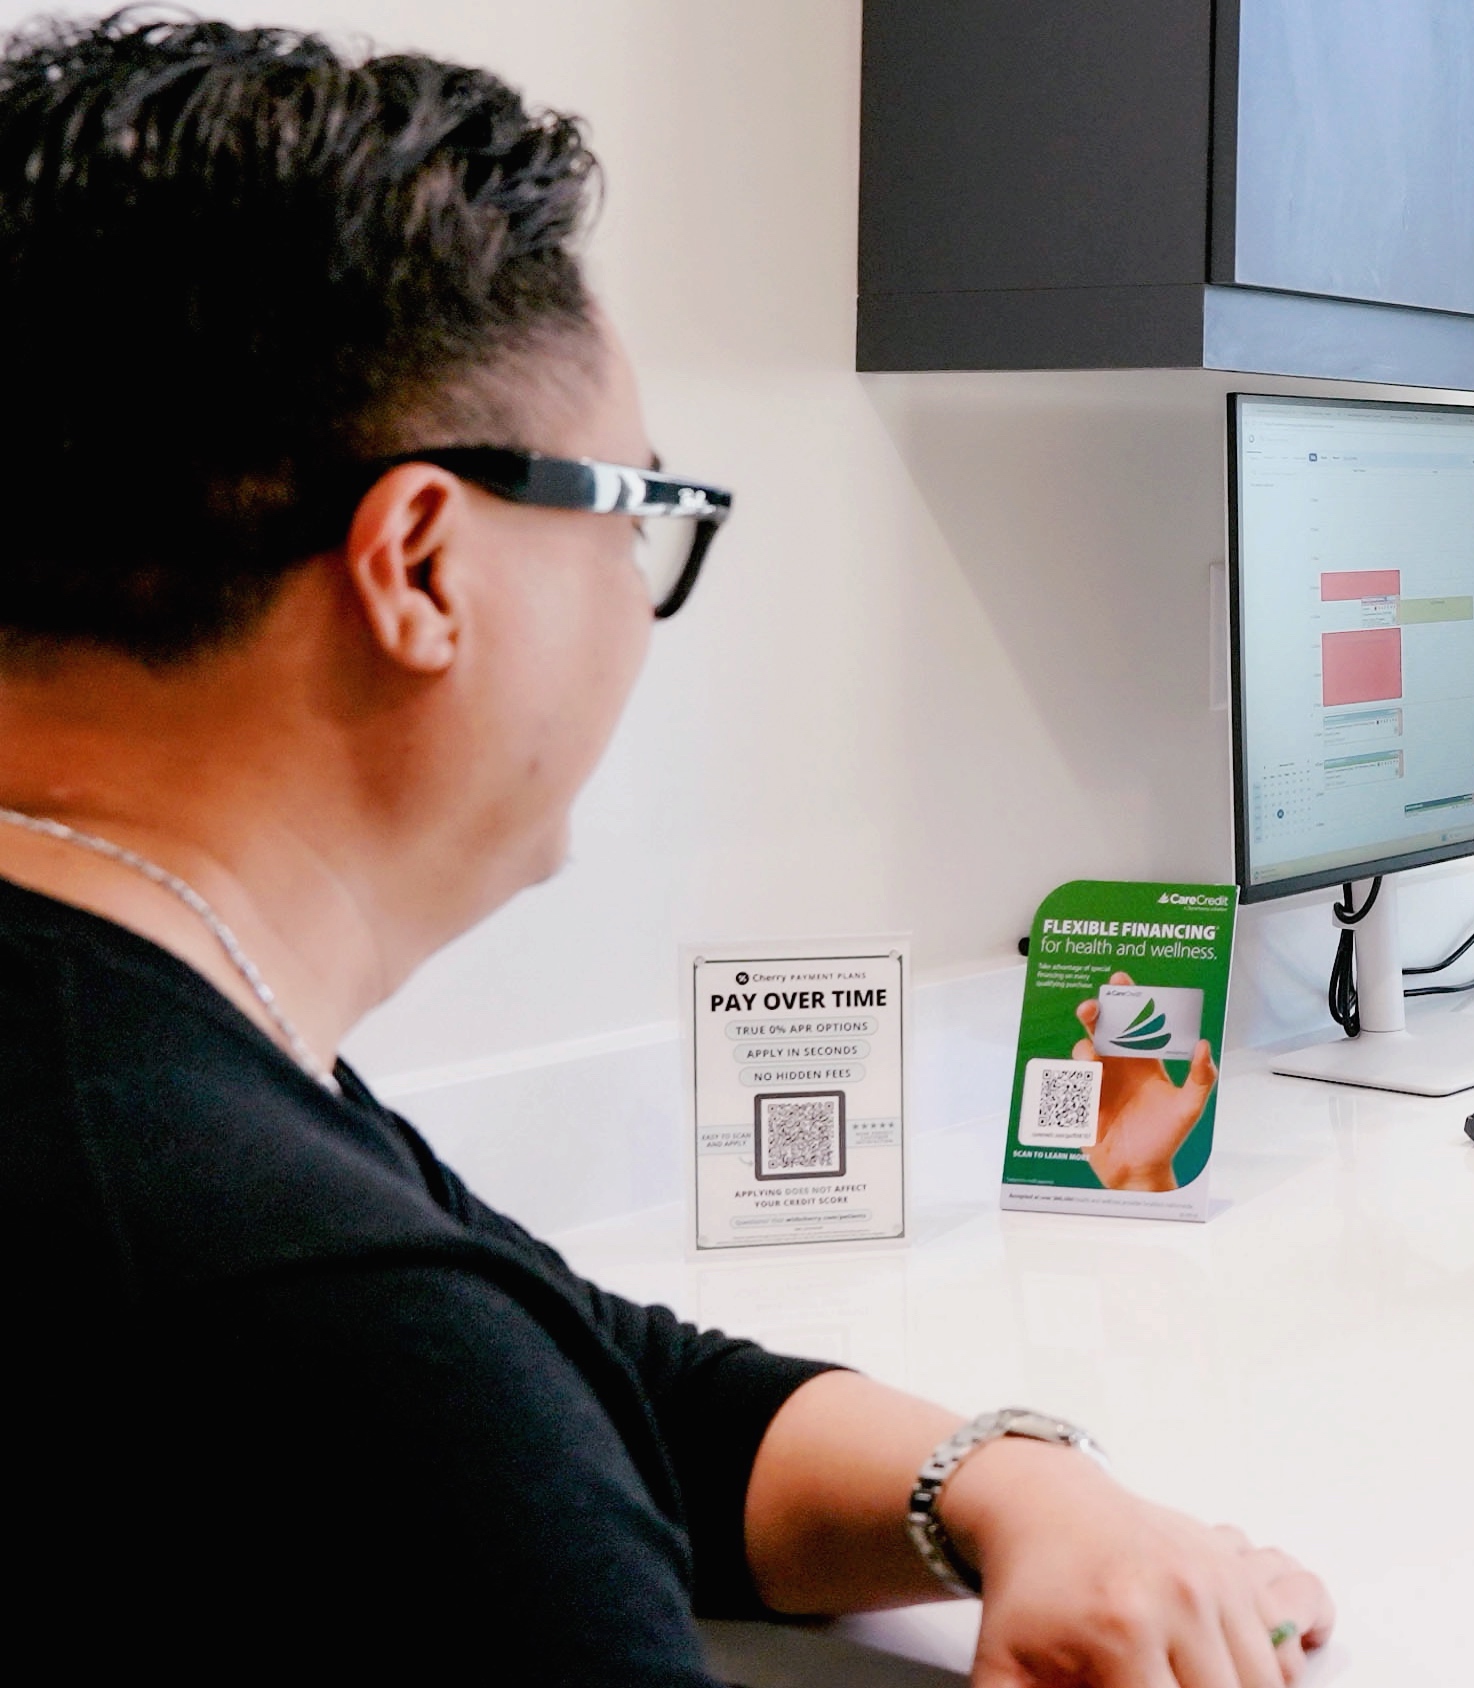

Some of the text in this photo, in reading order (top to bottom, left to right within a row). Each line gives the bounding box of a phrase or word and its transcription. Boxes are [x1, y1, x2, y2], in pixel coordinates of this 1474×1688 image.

[1170, 894, 1228, 906] CareCredit
[1043, 920, 1119, 936] FLEXIBLE
[1041, 938, 1217, 960] for health and wellness.
[753, 972, 866, 983] Cherry PAYMENT PLANS
[711, 989, 887, 1012] PAY OVER TIME
[736, 1022, 868, 1035] TRUE 0% APR OPTIONS
[747, 1046, 858, 1058] APPLY IN SECONDS
[754, 1069, 851, 1081] NO HIDDEN FEES
[1013, 1150, 1032, 1158] SCAN
[1044, 1152, 1068, 1160] LEARN
[735, 1189, 782, 1198] APPLYING
[811, 1186, 832, 1194] NOT
[834, 1184, 867, 1192] AFFECT
[755, 1196, 848, 1208] YOUR CREDIT SCORE
